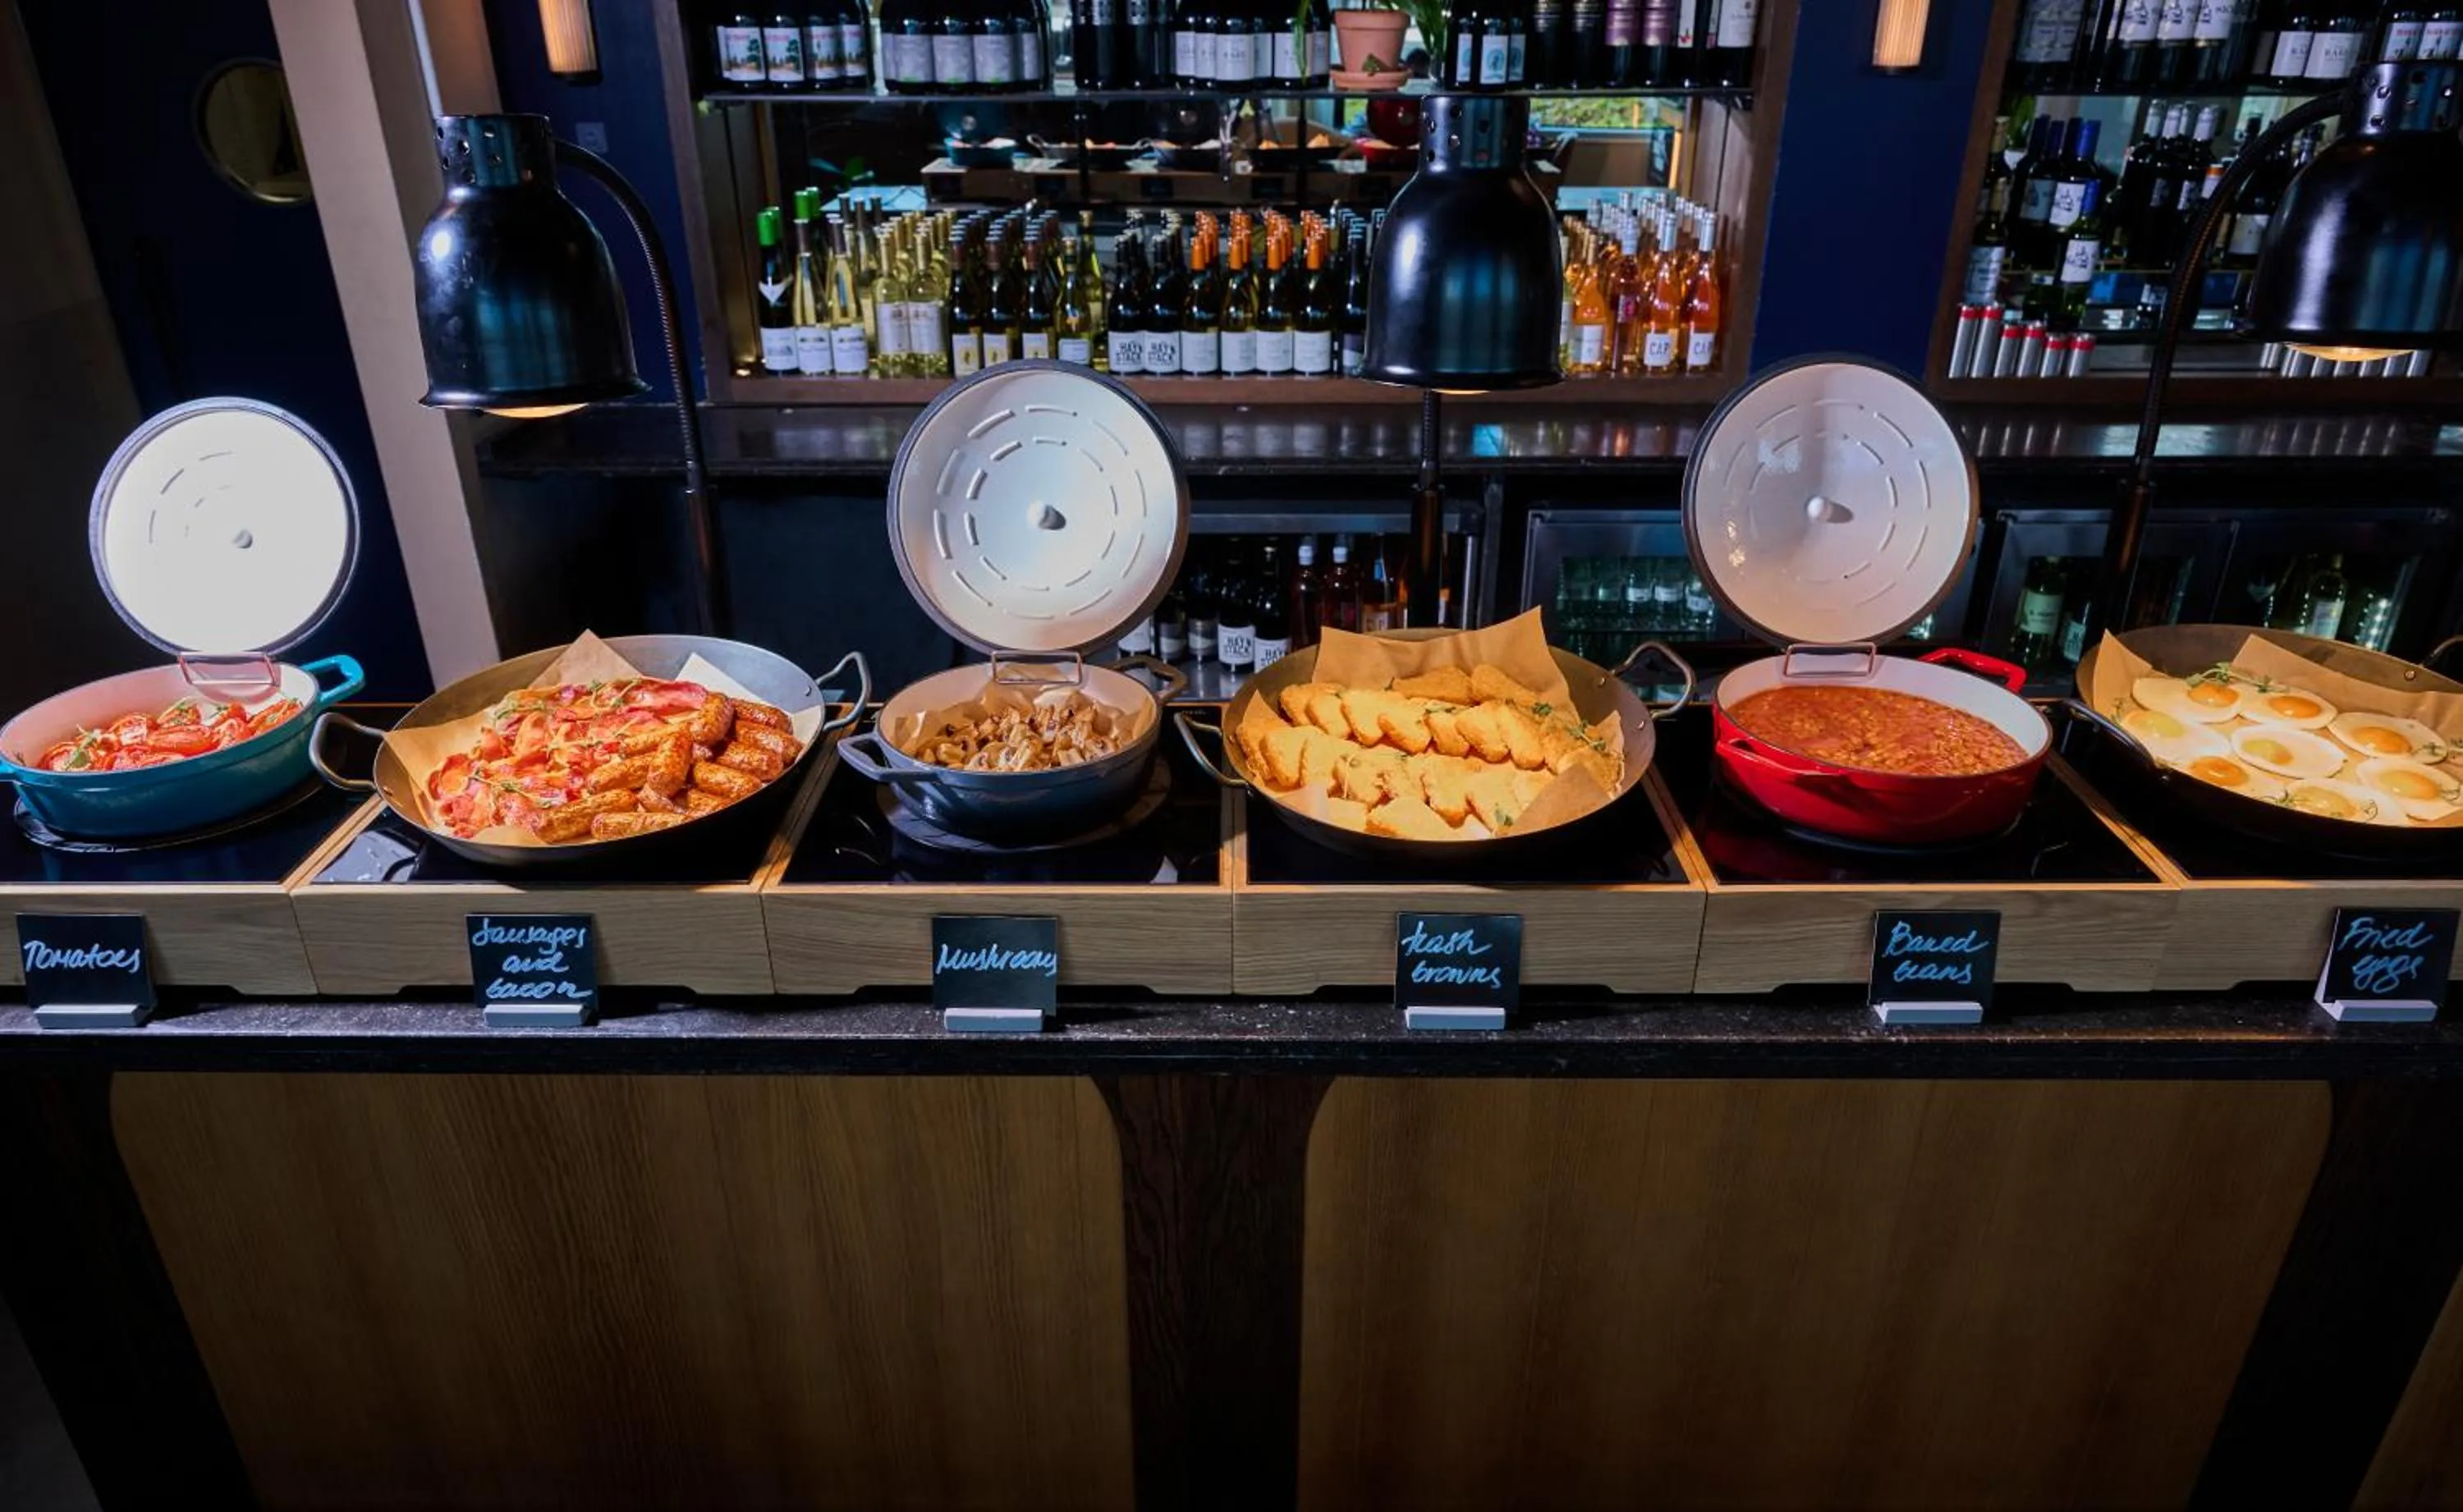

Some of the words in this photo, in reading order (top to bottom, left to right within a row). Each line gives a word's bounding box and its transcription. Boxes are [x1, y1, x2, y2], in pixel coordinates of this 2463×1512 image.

[472, 918, 586, 954] Sausages
[1881, 920, 1990, 958] Baked
[2337, 916, 2433, 951] Fried
[23, 940, 140, 974] Tomatoes
[502, 951, 570, 974] and
[1411, 960, 1501, 989] browns
[2351, 955, 2424, 993] eggs
